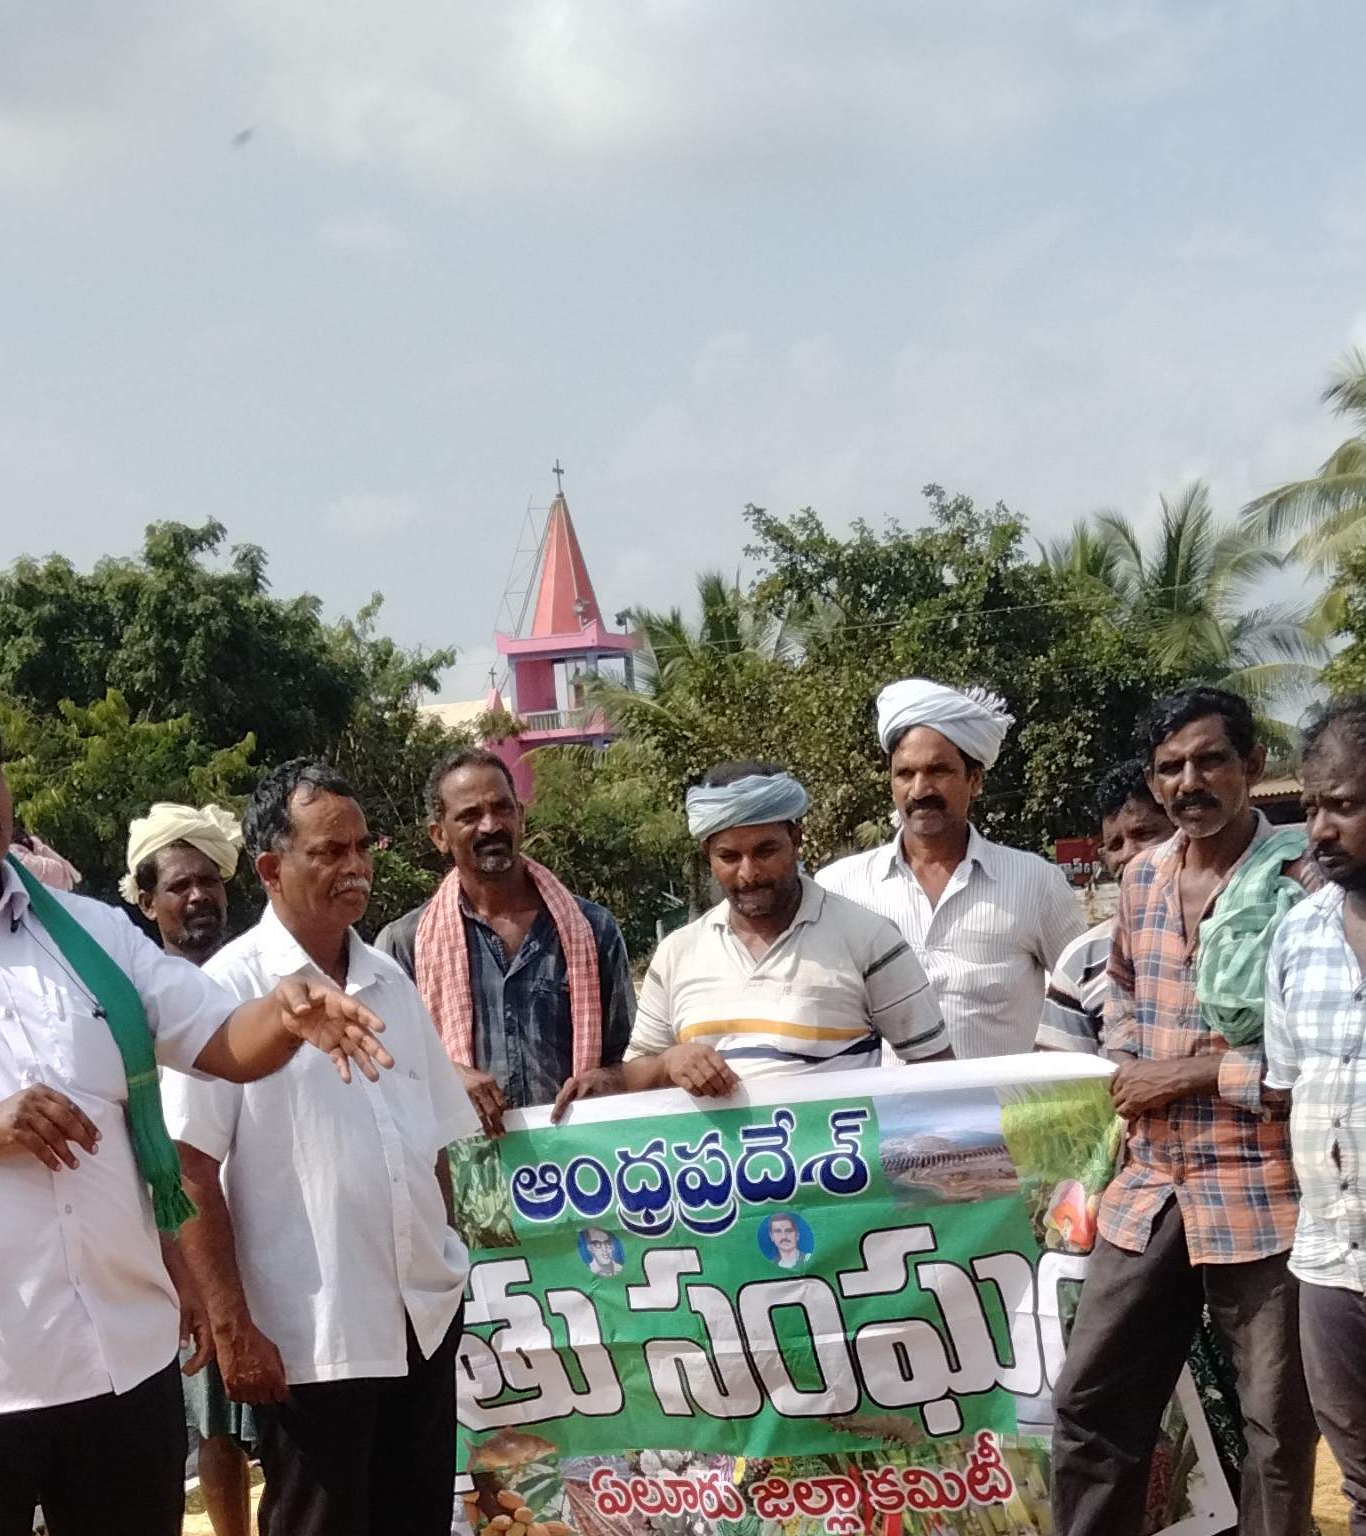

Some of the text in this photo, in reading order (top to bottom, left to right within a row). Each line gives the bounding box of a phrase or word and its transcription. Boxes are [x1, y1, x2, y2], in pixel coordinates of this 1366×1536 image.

[511, 1107, 871, 1237] ఆంధ్రప్రదేశ్
[589, 1466, 745, 1521] ఏలూరు
[866, 1428, 1016, 1514] కమిటీ
